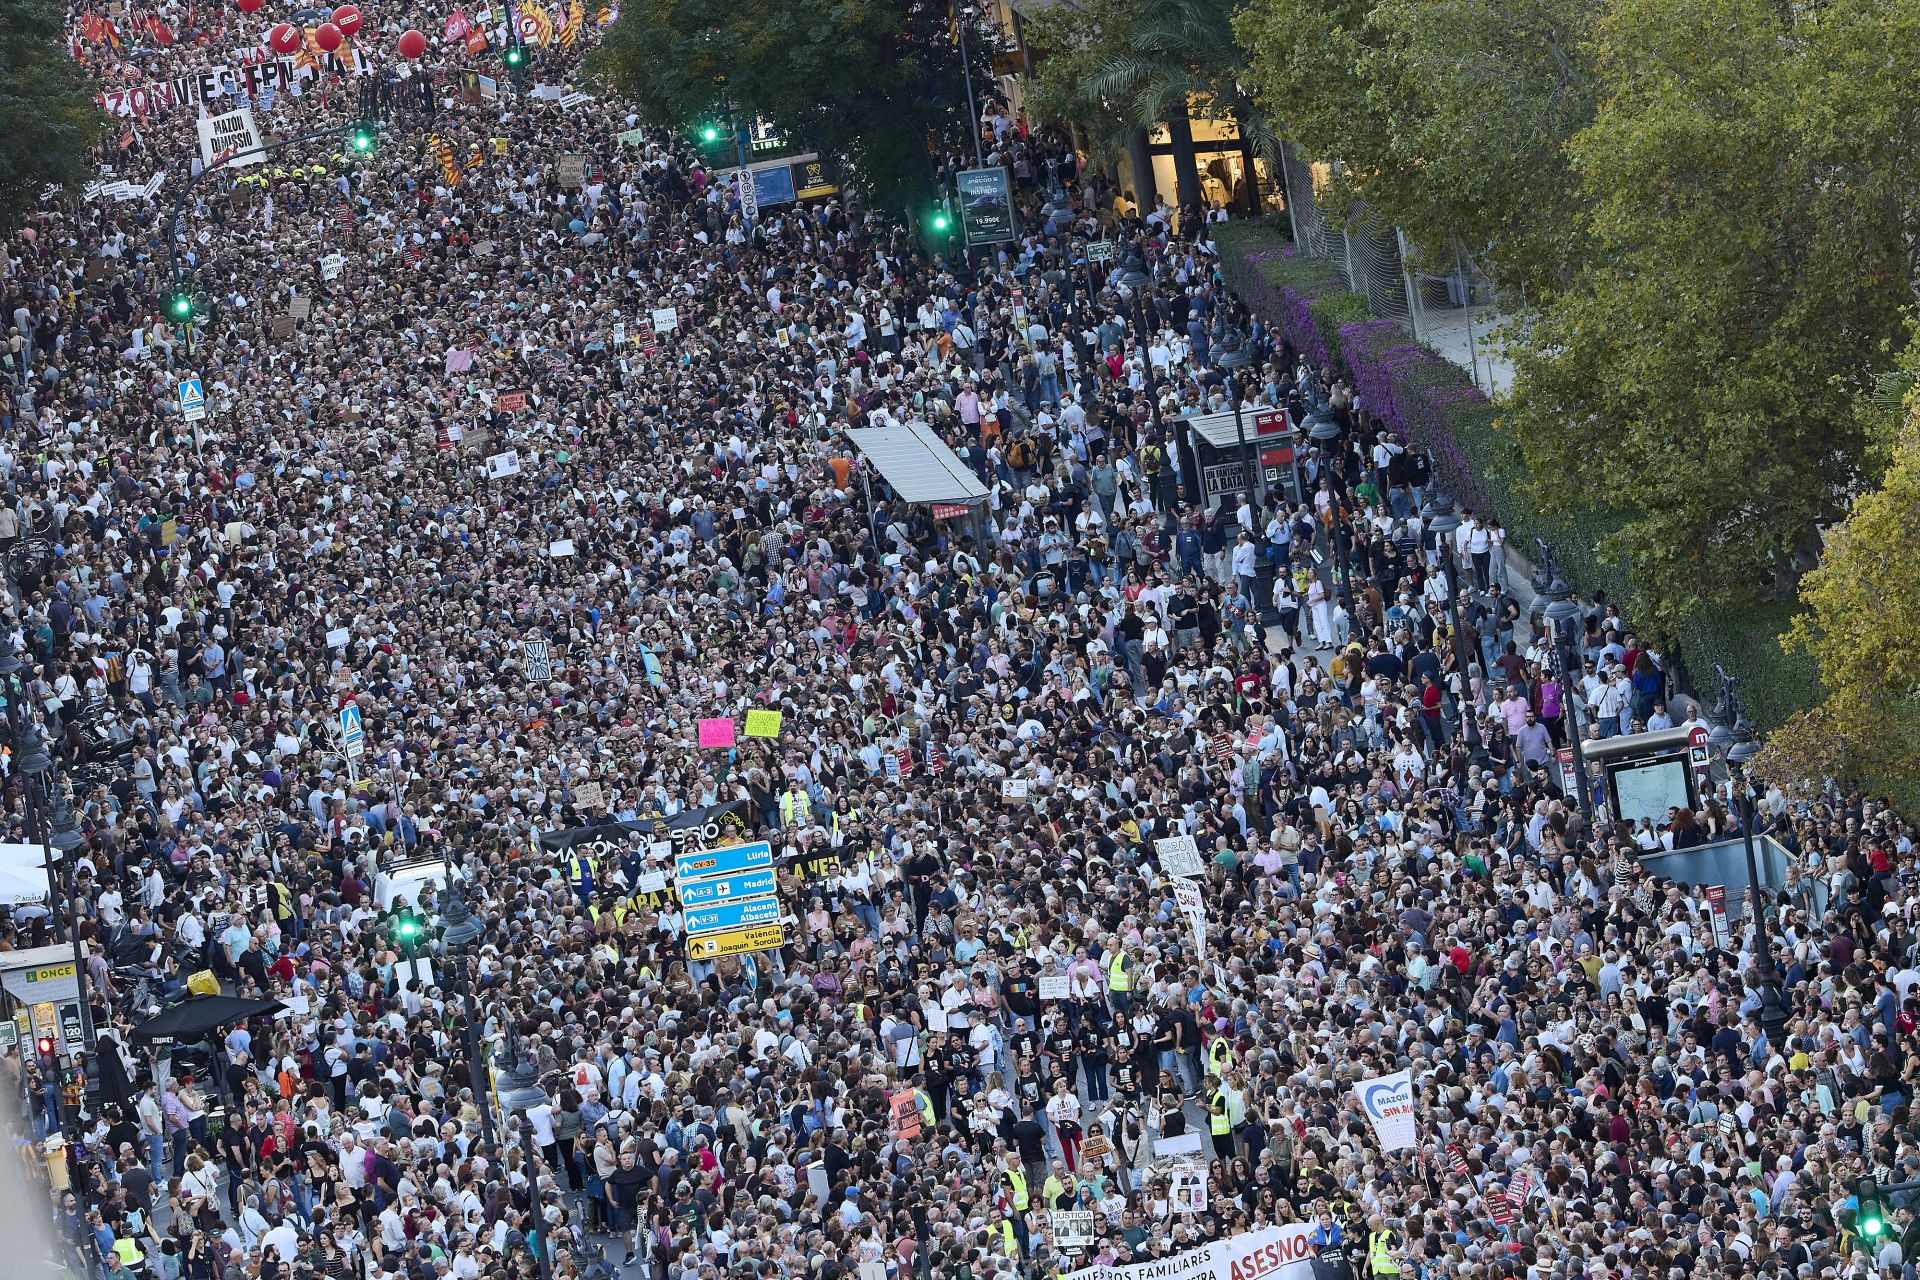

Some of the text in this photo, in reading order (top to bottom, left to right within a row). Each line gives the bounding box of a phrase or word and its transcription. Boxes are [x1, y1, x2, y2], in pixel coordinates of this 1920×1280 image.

[213, 115, 244, 135] MAZÓN
[211, 129, 253, 153] DIMISSIÓ
[546, 834, 623, 864] MAÓN
[694, 860, 715, 869] CV-35
[744, 877, 774, 889] Madrid
[700, 888, 711, 896] A-3
[744, 902, 777, 913] Alacant
[702, 915, 717, 923] V-31
[740, 910, 778, 922] Albacete
[754, 937, 781, 947] Sorolla
[41, 967, 71, 979] ONCE
[65, 1027, 81, 1036] 120
[1377, 1093, 1409, 1105] MAZON
[1054, 1211, 1092, 1220] JUSTICIA
[1139, 1250, 1211, 1280] FAMILIARES
